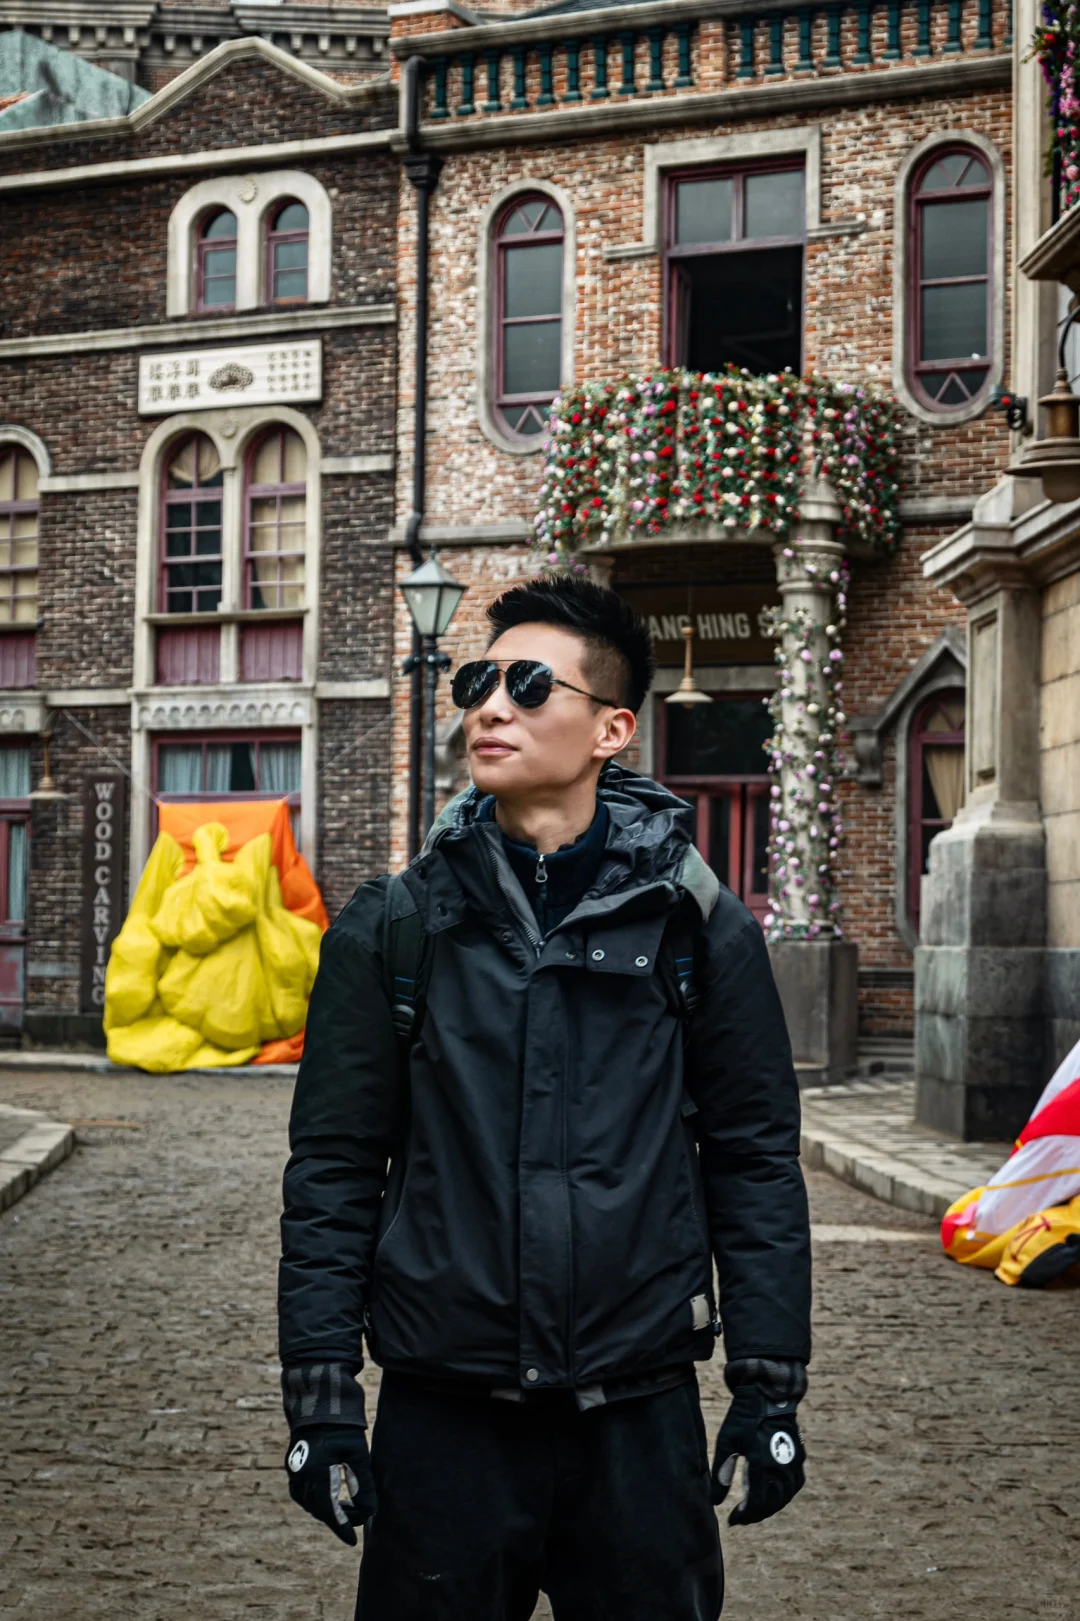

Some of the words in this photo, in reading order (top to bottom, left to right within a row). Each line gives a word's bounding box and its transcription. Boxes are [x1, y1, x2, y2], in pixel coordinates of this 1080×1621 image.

[642, 614, 691, 640] ANG
[696, 613, 751, 639] HING
[757, 612, 773, 638] S
[94, 782, 116, 861] WOOD
[91, 865, 112, 1005] CARVING
